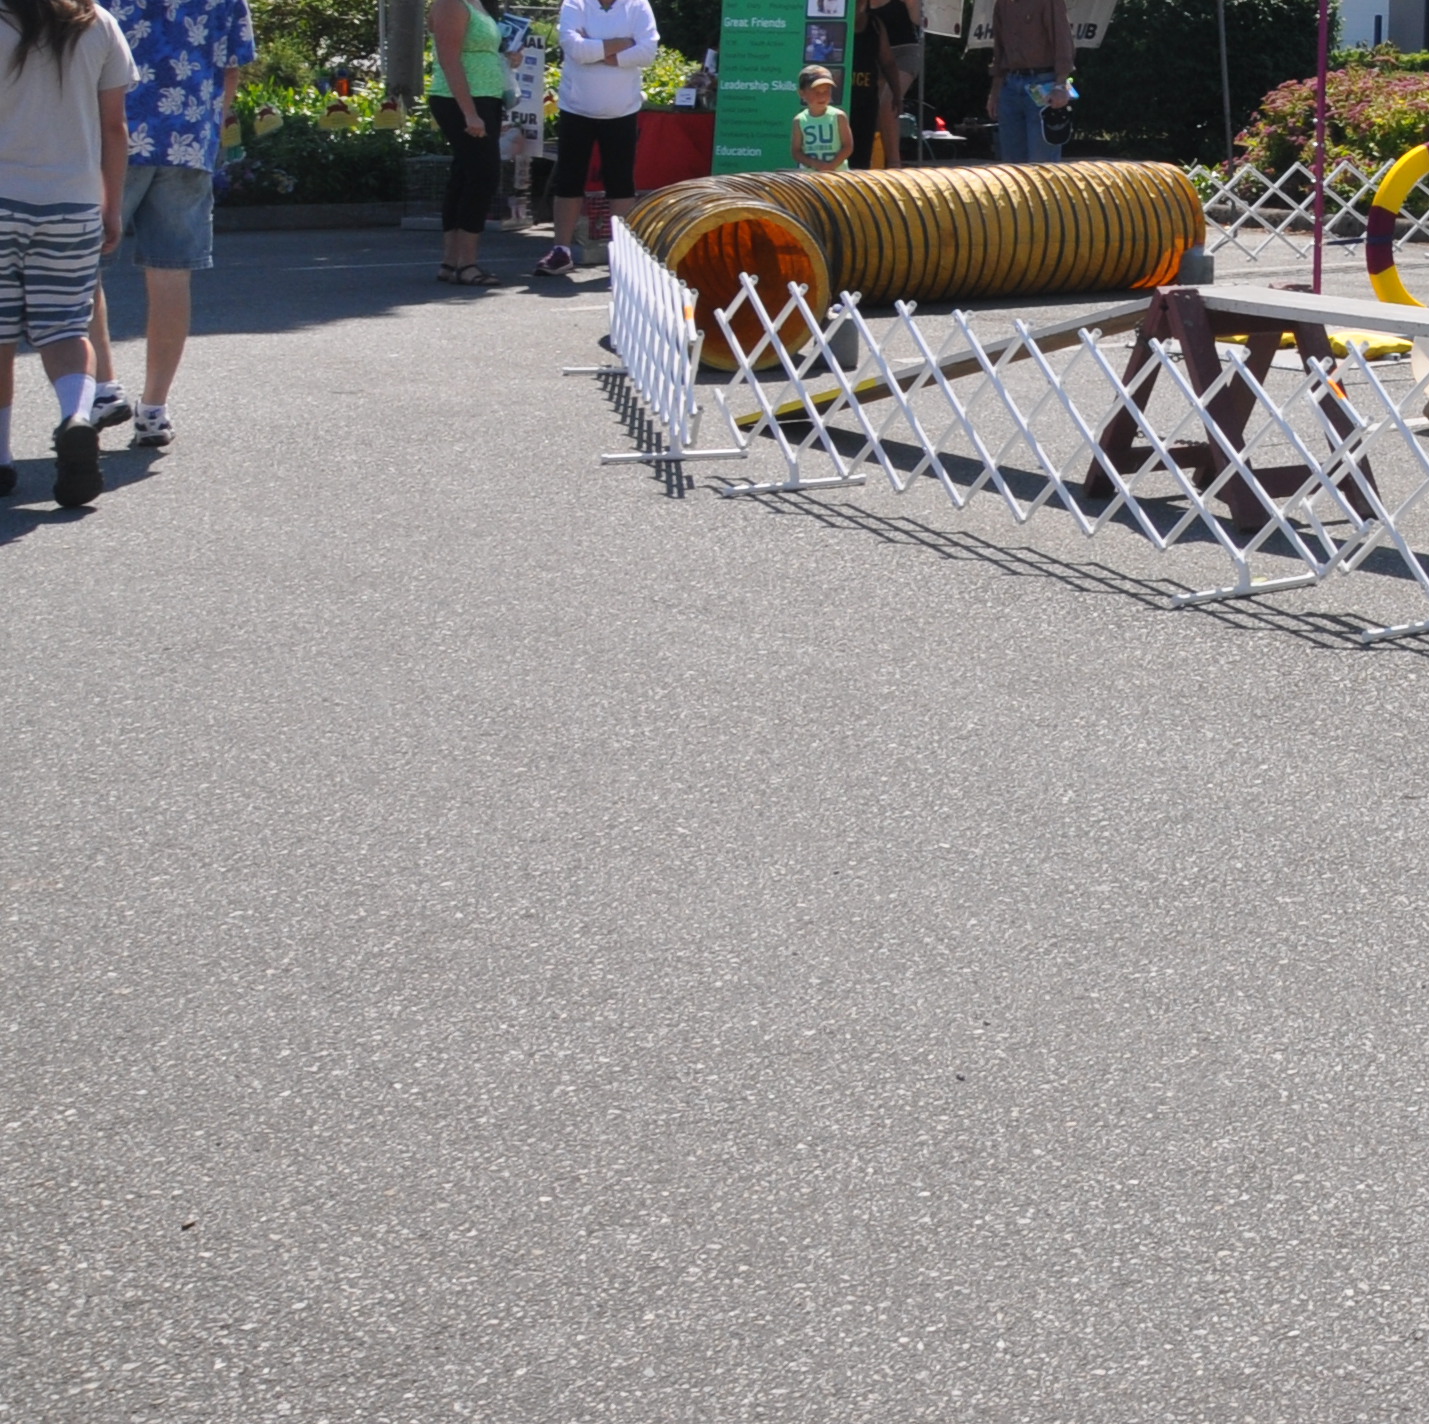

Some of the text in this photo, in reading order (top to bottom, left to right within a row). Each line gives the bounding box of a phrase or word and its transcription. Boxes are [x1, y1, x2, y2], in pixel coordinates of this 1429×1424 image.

[724, 17, 786, 28] Great Friends
[720, 79, 797, 93] Leadership Skills
[511, 111, 538, 125] FUR
[715, 145, 762, 157] Education
